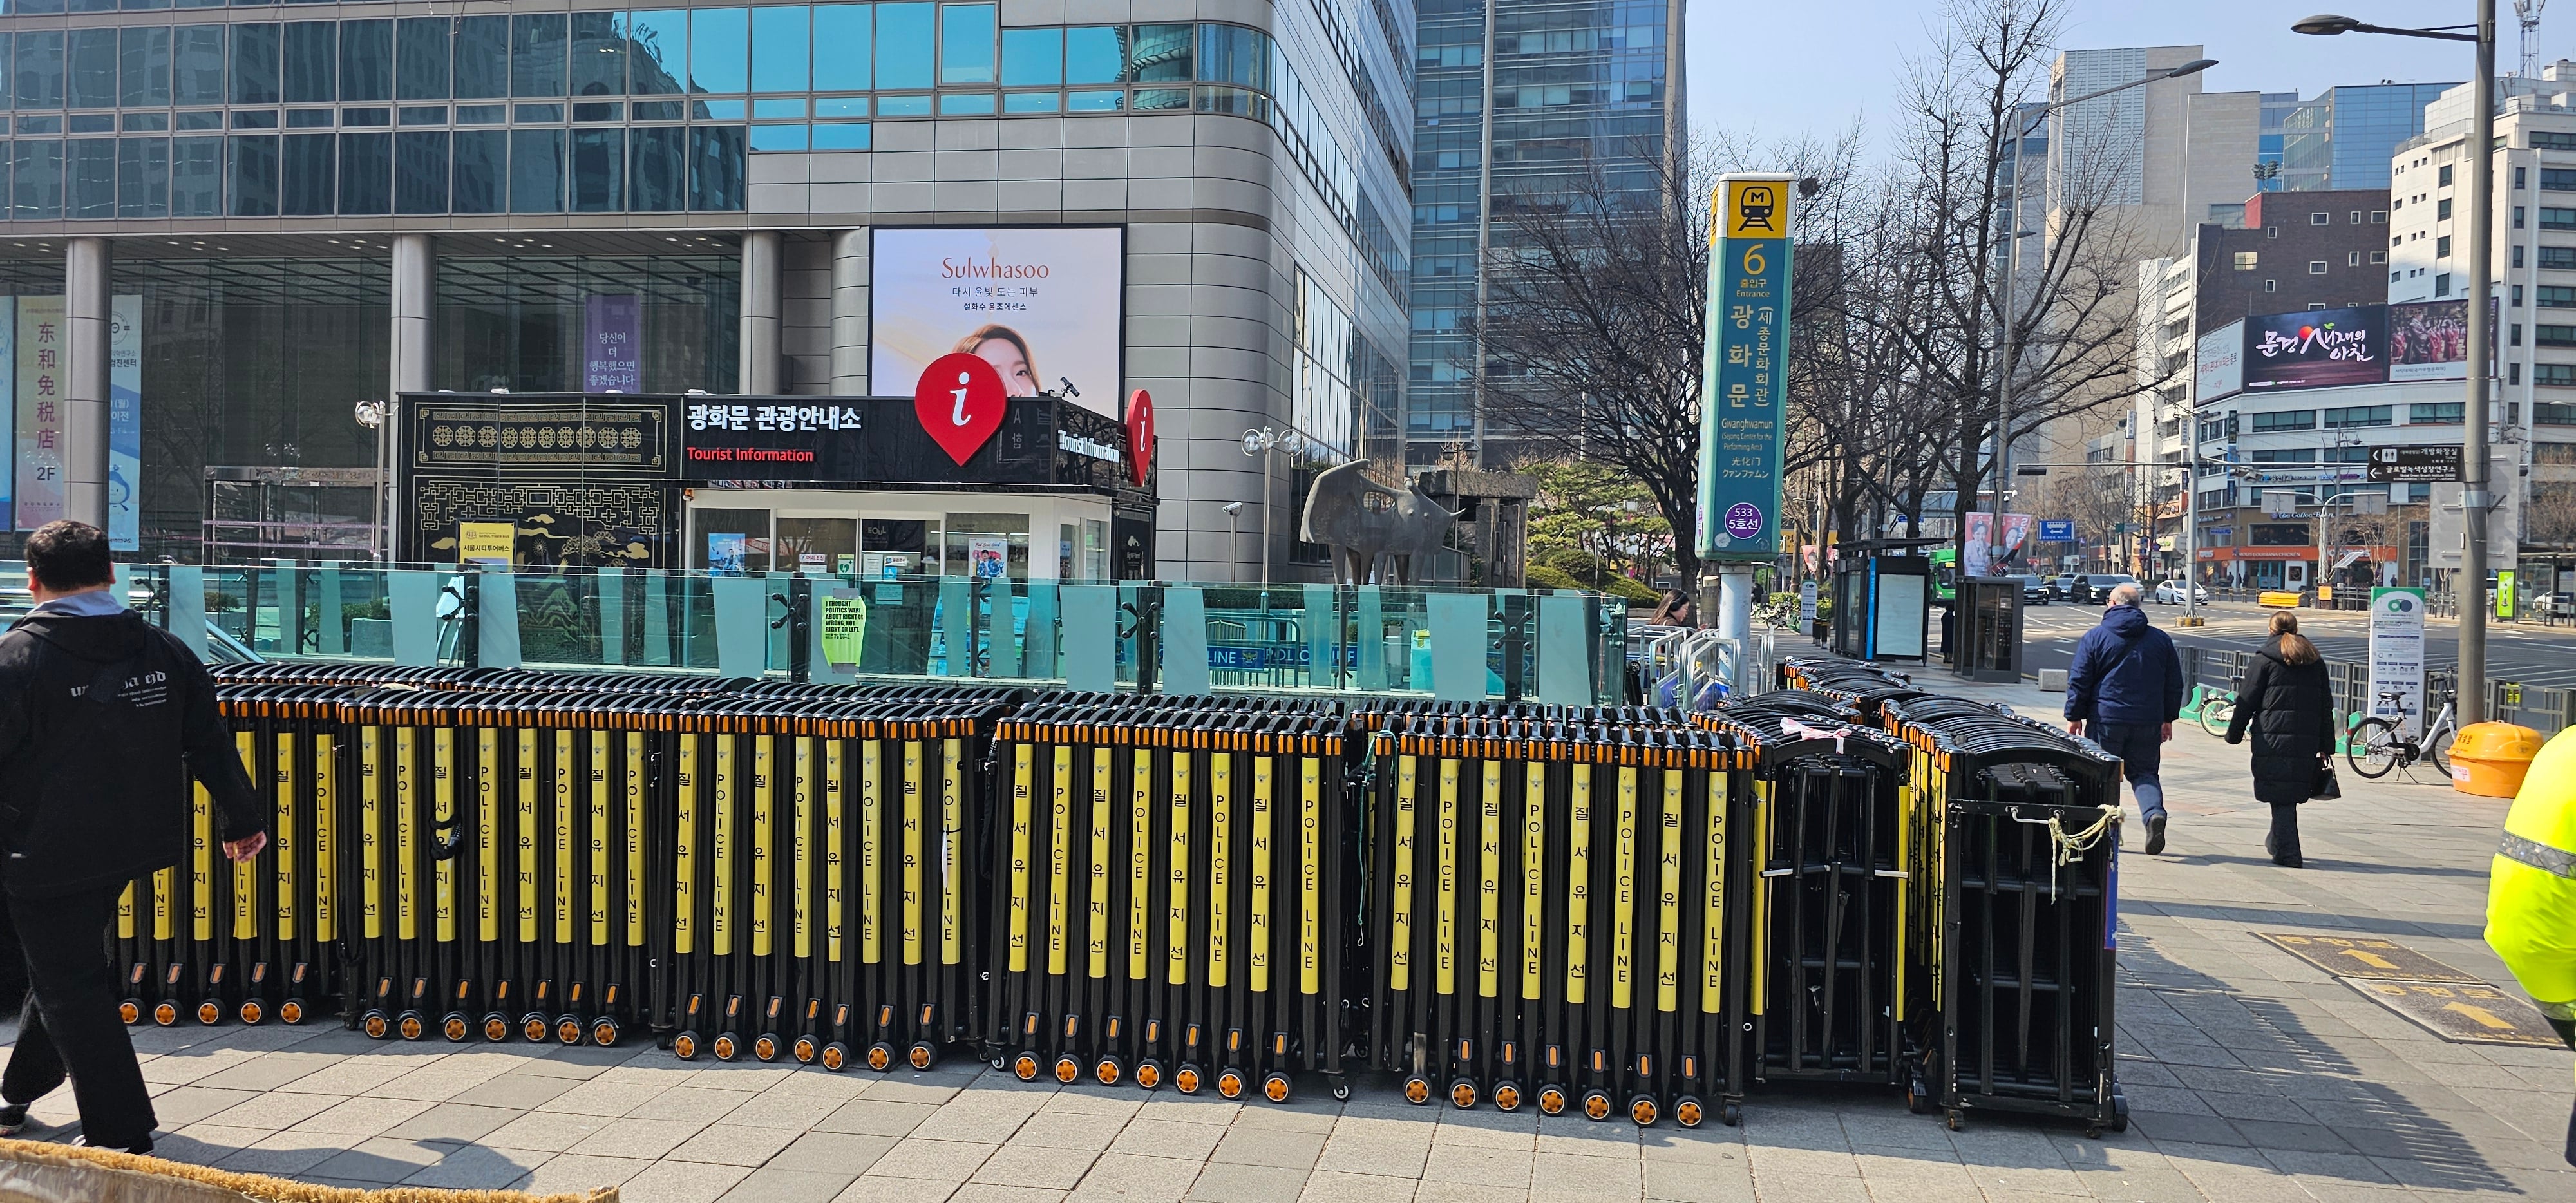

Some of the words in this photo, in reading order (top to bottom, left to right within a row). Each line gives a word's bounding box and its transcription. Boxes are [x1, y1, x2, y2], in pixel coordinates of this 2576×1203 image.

[942, 256, 1049, 278] Sulwhasoo
[952, 287, 971, 297] 다시
[974, 287, 993, 297] 윤빛
[997, 287, 1016, 297] 도는
[1019, 287, 1038, 297] 피부
[1740, 279, 1767, 288] 출입구
[1743, 244, 1765, 274] 6
[600, 332, 626, 344] 당신이
[964, 303, 986, 311] 설화수
[989, 303, 1027, 311] 윤조에센스
[2256, 331, 2298, 357] 문경
[37, 322, 55, 449] 东和免税店
[589, 361, 636, 372] 행복했으면
[589, 375, 636, 386] 좋겠습니다
[609, 347, 617, 357] 더
[1727, 305, 1754, 407] 광화문
[1754, 307, 1774, 407] (세종문화회관)
[2329, 343, 2374, 361] 아침
[687, 404, 750, 430] 광화문
[755, 405, 862, 431] 관광안내소
[687, 447, 732, 460] Tourist
[736, 448, 814, 462] Information
[1058, 430, 1084, 455] Tourist
[1085, 437, 1120, 464] Information
[1721, 418, 1773, 431] Gwanghwamun
[1722, 432, 1740, 441] (Sejong
[1723, 443, 1750, 452] Performing
[2421, 448, 2458, 456] 개방화장실
[37, 467, 55, 480] 2F
[1723, 469, 1769, 478] クァンファムン
[1731, 457, 1761, 466] 光化门
[1728, 519, 1758, 530] 5호선
[1734, 508, 1752, 517] 533
[278, 770, 291, 918] 질서유지선
[316, 773, 327, 851] POLICE
[362, 764, 375, 916] 질서유지선
[397, 765, 408, 847] POLICE
[480, 766, 489, 848] POLICE
[519, 767, 533, 920] 질서유지선
[557, 768, 567, 850] POLICE
[592, 769, 604, 923] 질서유지선
[628, 770, 638, 853] POLICE
[715, 774, 726, 859] POLICE
[795, 777, 805, 862] POLICE
[863, 781, 873, 867] POLICE
[1054, 788, 1065, 875] POLICE
[1135, 791, 1145, 878] POLICE
[1215, 795, 1225, 884] POLICE
[1304, 800, 1315, 891] POLICE
[1441, 801, 1452, 891] POLICE
[193, 775, 206, 918] 서유지선
[676, 773, 690, 930] 질서유지선
[753, 774, 766, 933] 질서유지선
[827, 779, 841, 938] 질서유지선
[904, 781, 916, 942] 질서유지선
[1011, 785, 1028, 948] 질서유지선
[1090, 789, 1106, 953] 질서유지선
[1170, 794, 1187, 960] 질서유지선
[1252, 799, 1267, 967] 질서유지선
[1394, 797, 1413, 965] 질서유지선
[1529, 804, 1540, 896] POLICE
[1620, 810, 1632, 903] POLICE
[1710, 815, 1723, 908] POLICE
[238, 866, 247, 917] LINE
[319, 868, 327, 919] LINE
[943, 887, 952, 940] LINE
[1052, 893, 1061, 951] LINE
[1133, 897, 1142, 955] LINE
[1481, 802, 1498, 972] 질서유지선
[1571, 806, 1589, 979] 질서유지선
[1660, 813, 1678, 987] 질서유지선
[1214, 903, 1222, 962] LINE
[1304, 910, 1313, 969] LINE
[1440, 911, 1450, 969] LINE
[1528, 914, 1537, 974] LINE
[1618, 922, 1628, 983] LINE
[1709, 927, 1719, 988] LINE
